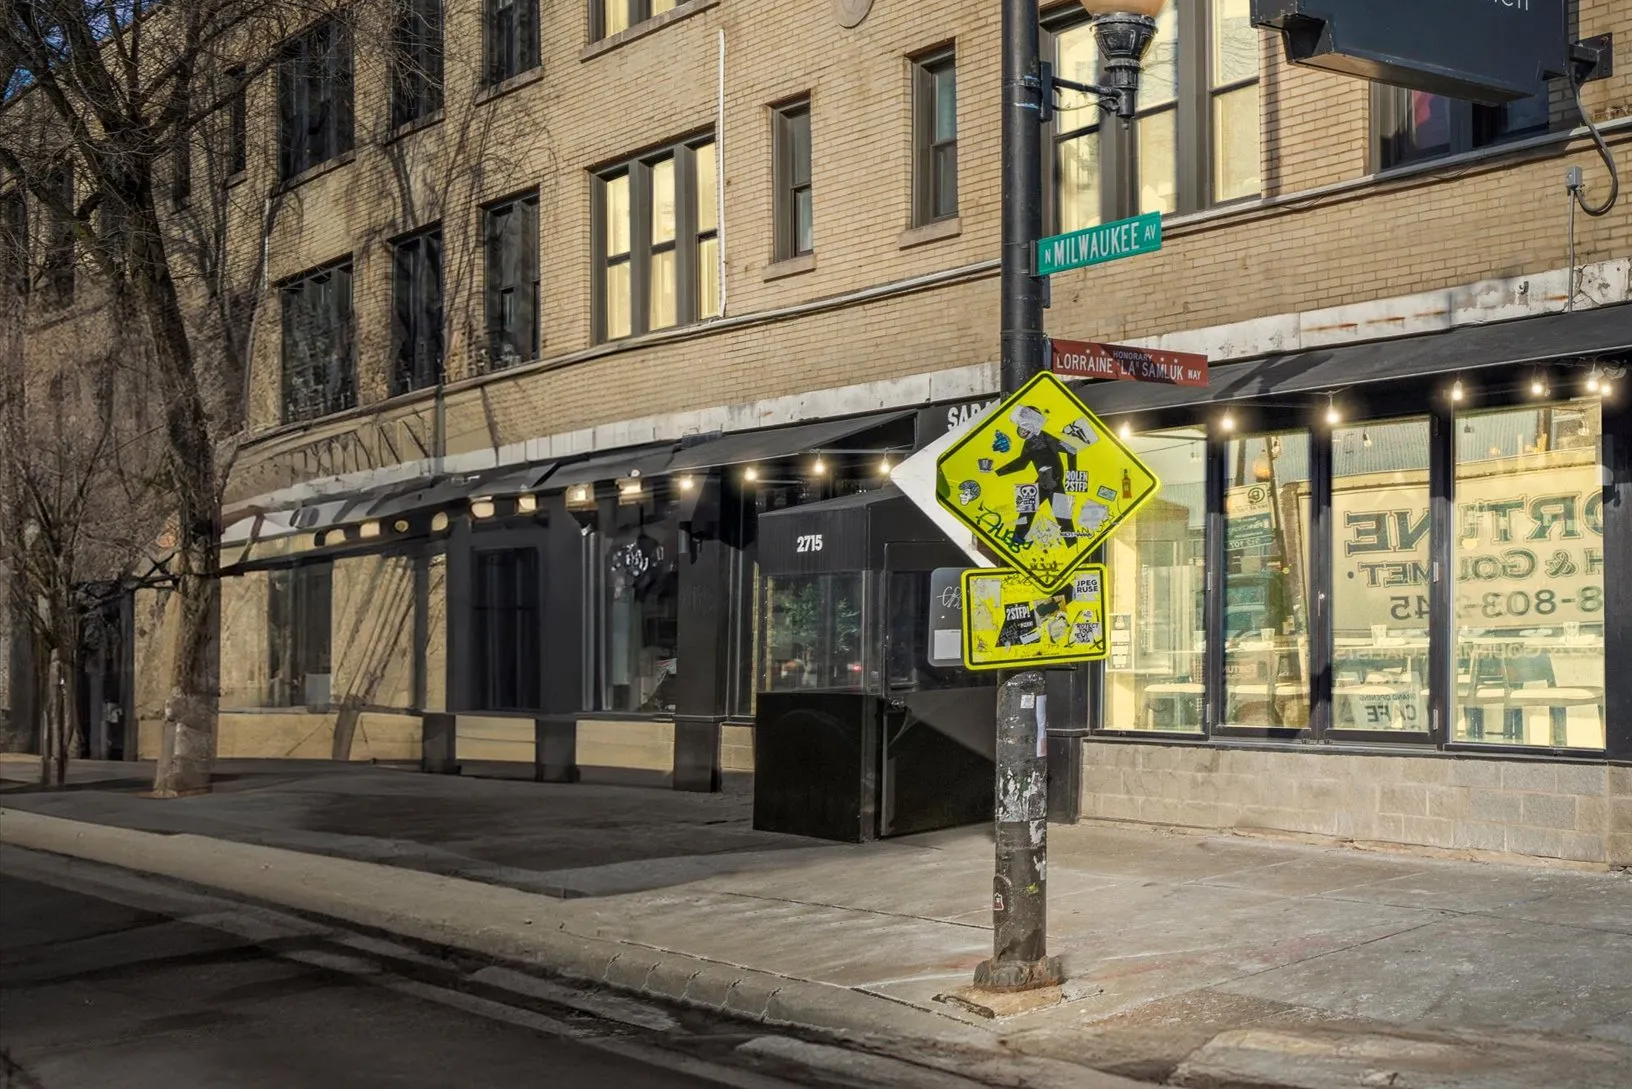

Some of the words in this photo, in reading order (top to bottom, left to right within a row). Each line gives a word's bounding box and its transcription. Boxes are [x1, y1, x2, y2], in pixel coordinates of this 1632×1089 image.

[1045, 249, 1051, 263] N
[1053, 222, 1140, 267] MILWAUKEE
[1144, 224, 1156, 241] AV
[1112, 350, 1153, 361] HONORARY
[1056, 353, 1113, 373] LORRAINE
[1188, 369, 1201, 380] WAY
[797, 534, 823, 552] 2715
[1076, 579, 1098, 587] JPEG
